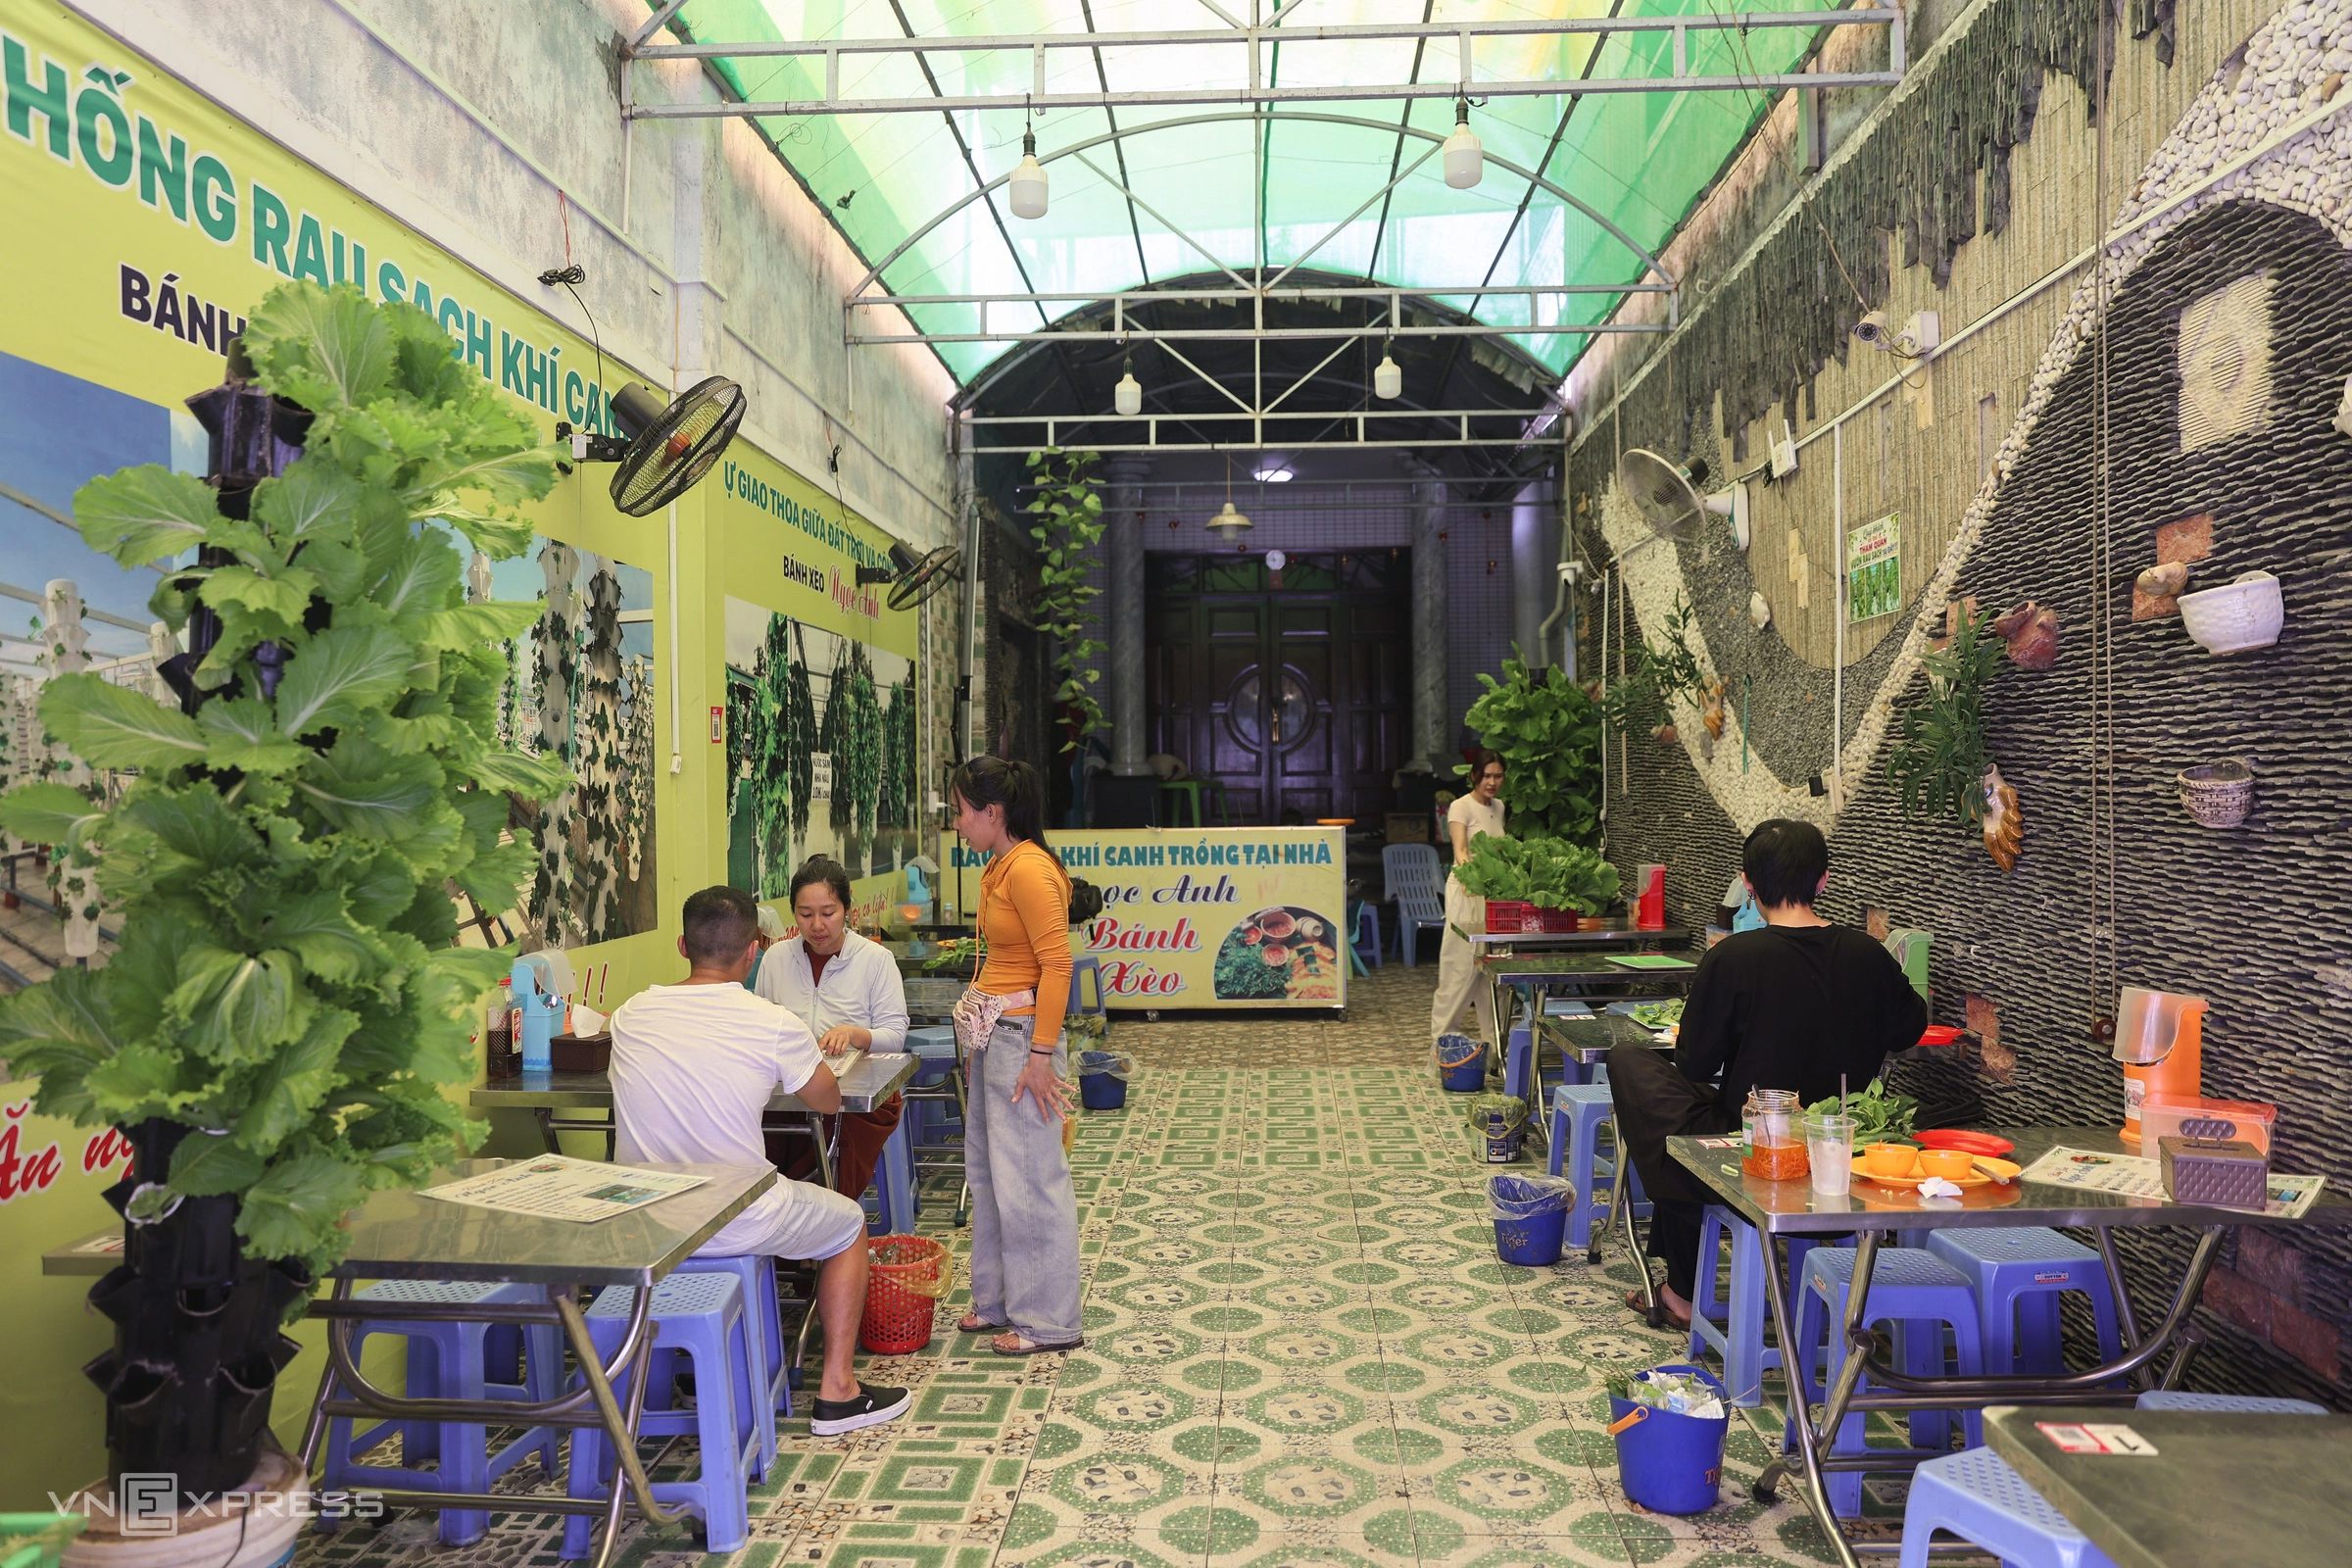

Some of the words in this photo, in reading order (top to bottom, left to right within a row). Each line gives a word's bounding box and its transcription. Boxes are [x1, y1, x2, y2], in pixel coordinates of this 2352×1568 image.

[121, 264, 246, 357] BÁNH
[253, 183, 366, 298] RAU
[502, 330, 562, 414] KHÍ
[738, 469, 767, 511] GIAO
[769, 487, 800, 529] THOA
[802, 508, 826, 543] GIỮA
[828, 519, 845, 554] ĐẤT
[783, 553, 808, 586] BÁNH
[808, 564, 825, 593] XÈO
[829, 564, 856, 614] Ngọc
[1061, 842, 1100, 866] KHÍ
[1104, 846, 1164, 866] CANH
[1243, 844, 1279, 869] TẠI
[1284, 839, 1333, 865] NHÀ
[1152, 874, 1241, 905] Anh
[1081, 917, 1201, 950] Bánh
[1100, 960, 1184, 994] Xèo
[1500, 1232, 1529, 1250] Tiger
